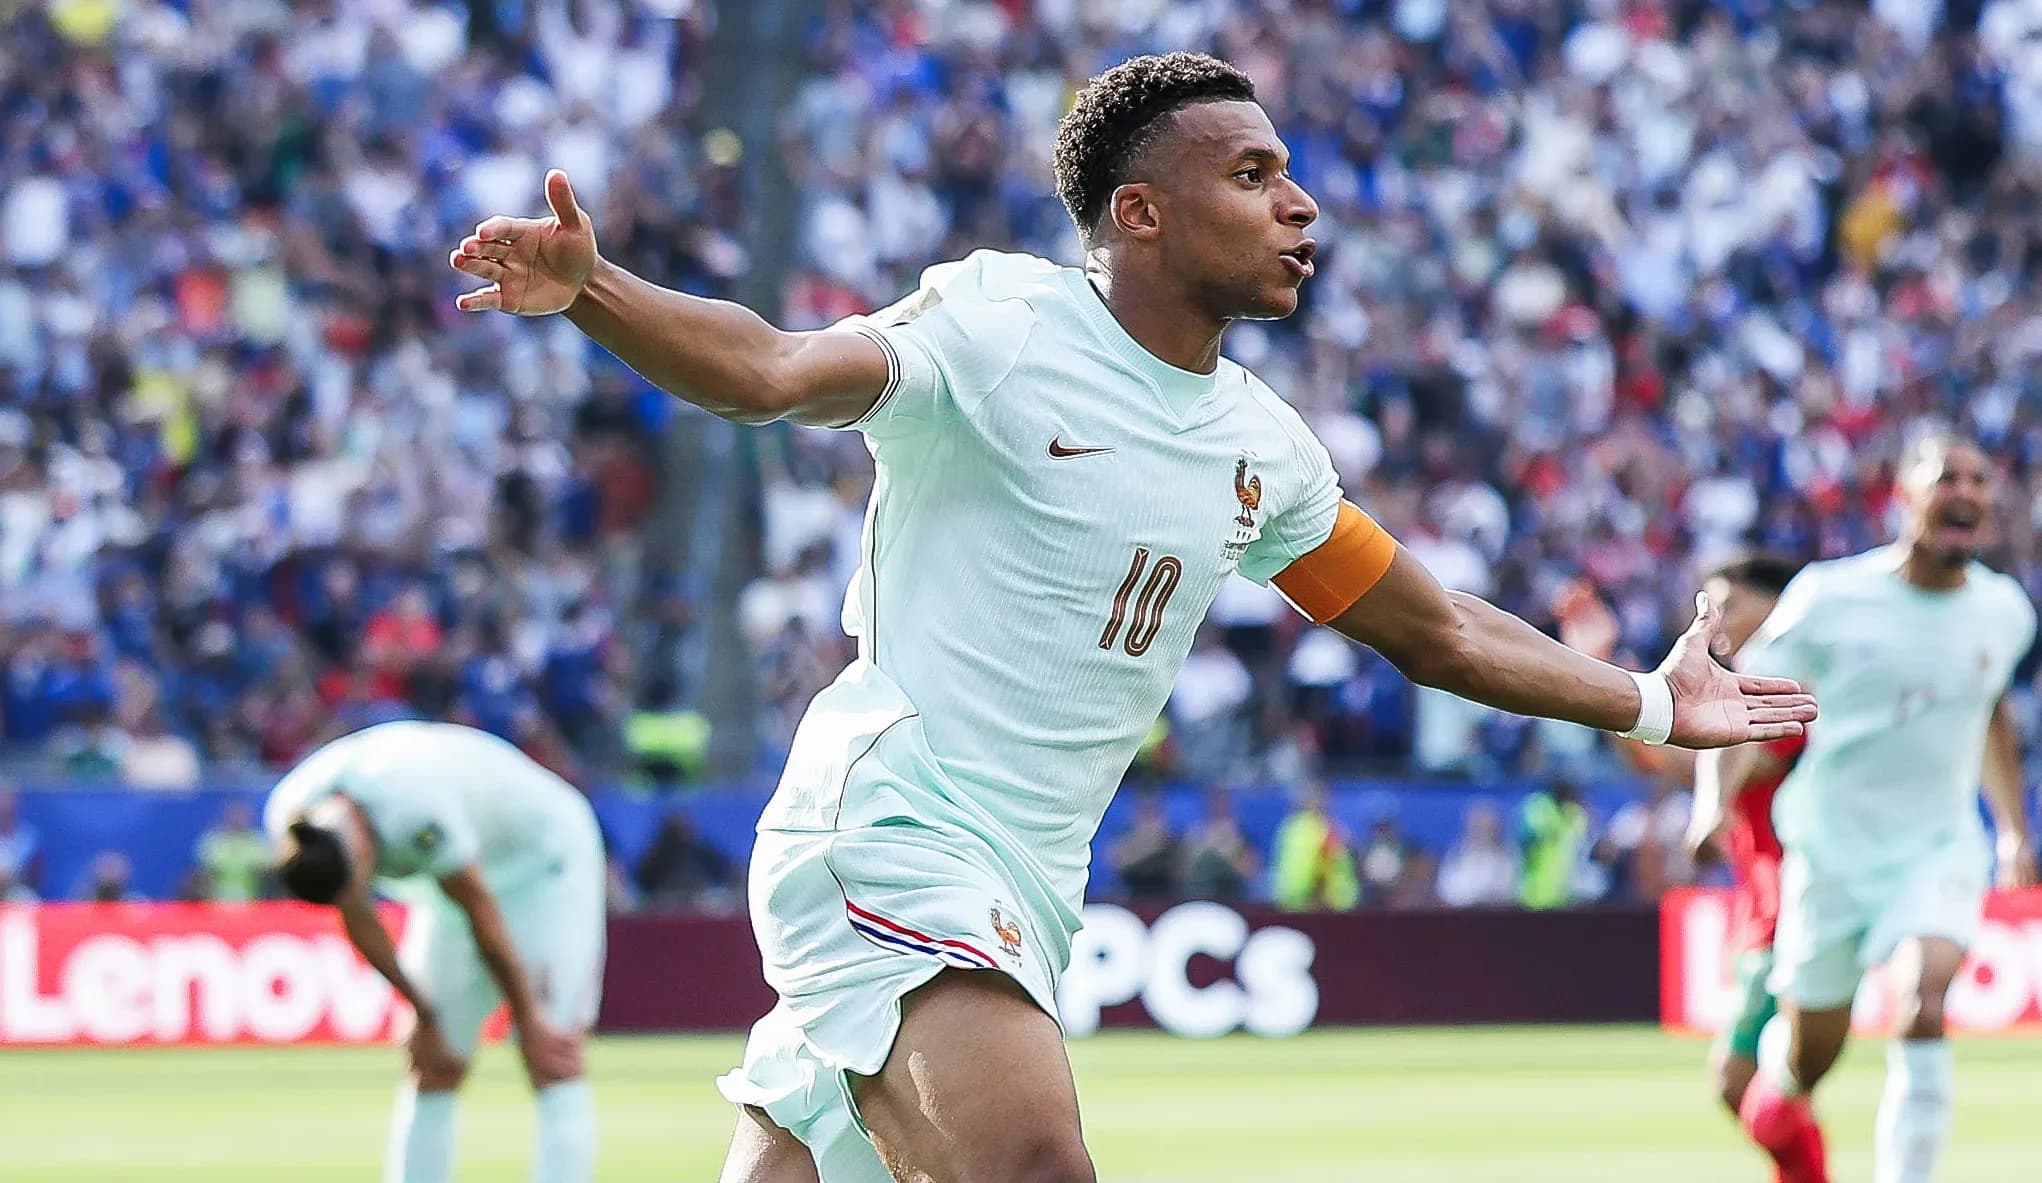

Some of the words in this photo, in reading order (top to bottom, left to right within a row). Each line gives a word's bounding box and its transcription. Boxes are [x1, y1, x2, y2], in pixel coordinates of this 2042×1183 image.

[1098, 547, 1182, 657] 10
[0, 908, 398, 1043] Lenov
[1053, 900, 1320, 1038] PCs
